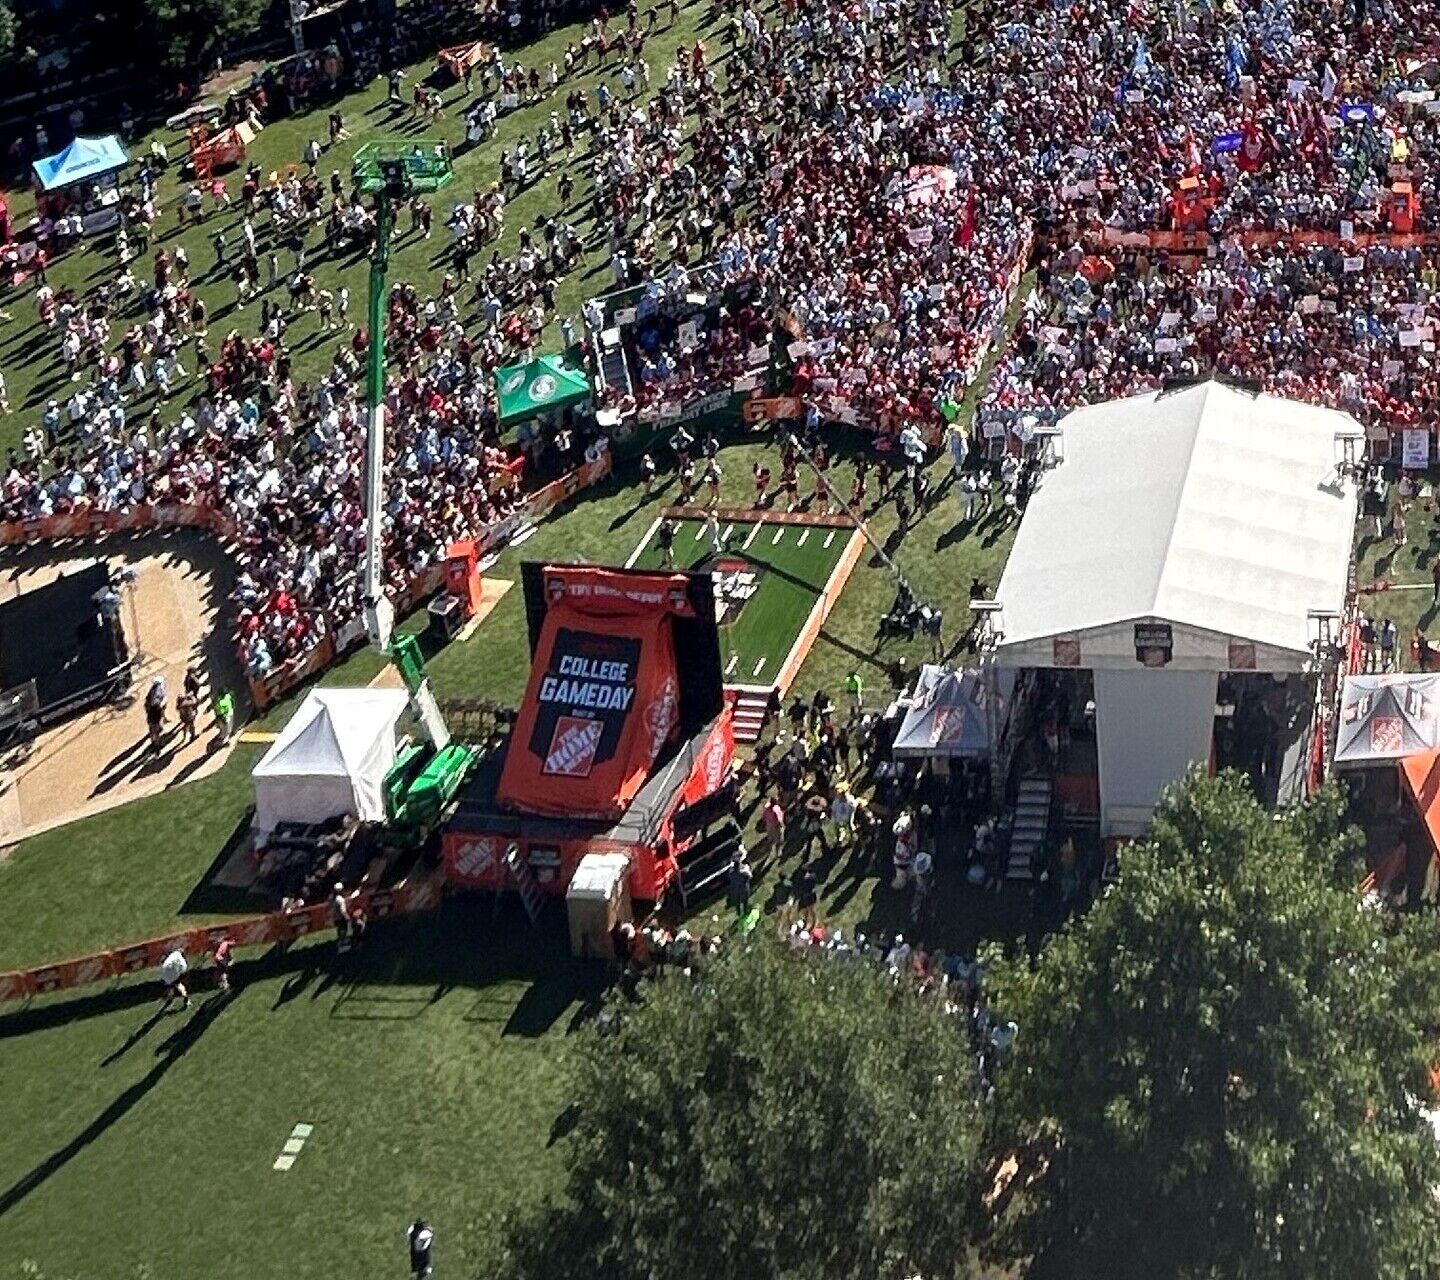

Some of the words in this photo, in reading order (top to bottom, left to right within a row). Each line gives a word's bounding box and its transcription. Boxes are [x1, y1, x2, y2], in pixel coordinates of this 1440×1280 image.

[560, 655, 630, 682] COLLEGE
[539, 676, 634, 710] GAMEDAY
[547, 721, 601, 771] HOME
